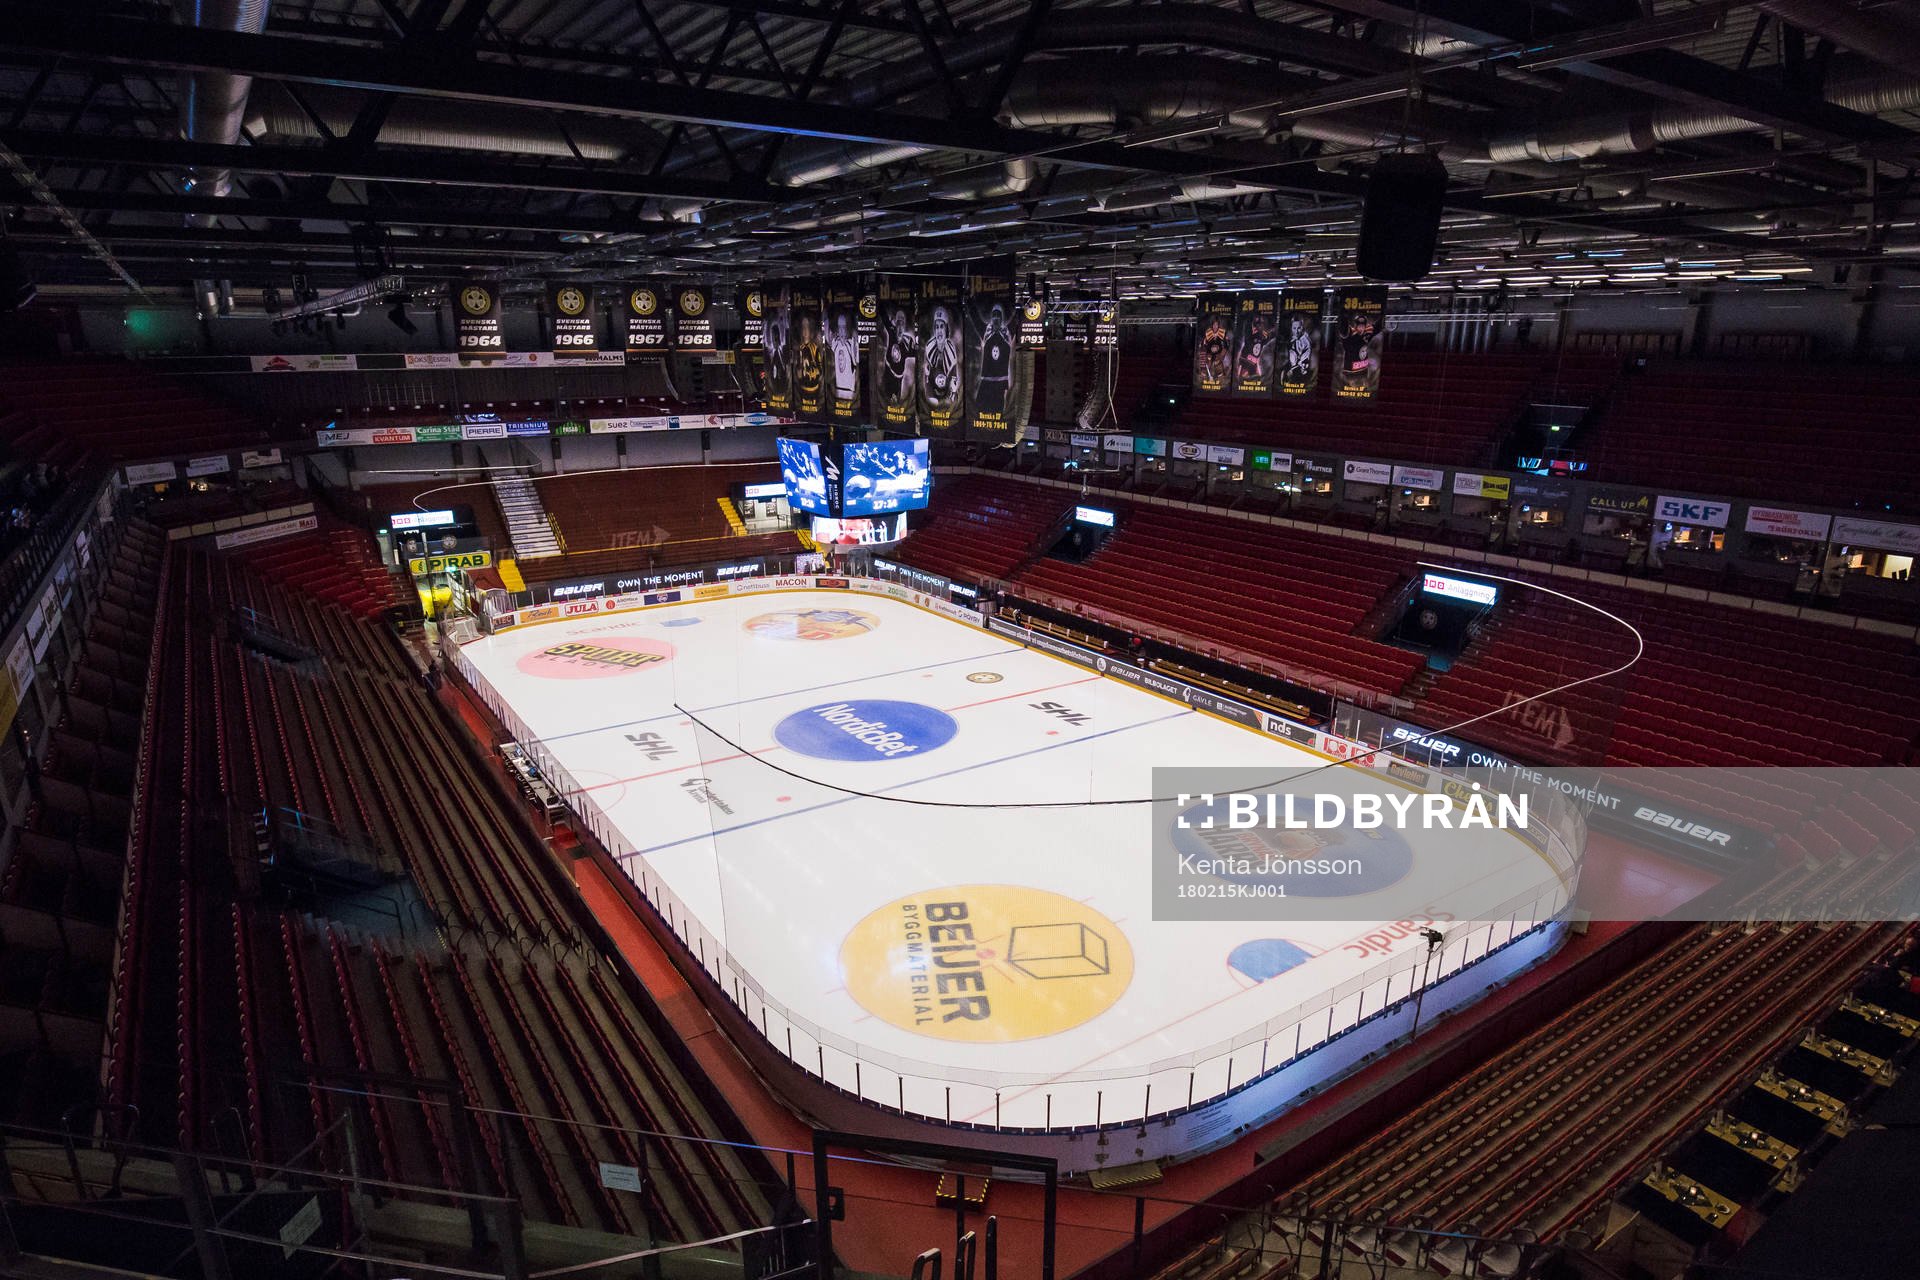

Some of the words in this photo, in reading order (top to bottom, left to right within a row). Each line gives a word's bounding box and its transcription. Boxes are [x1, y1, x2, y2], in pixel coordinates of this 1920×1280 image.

[459, 335, 501, 347] 1964
[555, 334, 594, 346] 1966
[628, 334, 665, 345] 1967
[677, 334, 713, 345] 1968
[468, 428, 501, 436] PIERRE
[507, 422, 548, 430] TRIENNIUM
[374, 434, 412, 443] KVANTUM
[1590, 496, 1616, 507] CALL
[1621, 501, 1636, 510] UP
[1661, 500, 1724, 521] SKF
[430, 554, 484, 571] PIRAB
[553, 582, 605, 597] BAUER
[618, 577, 640, 589] OWN
[643, 575, 662, 585] THE
[664, 571, 704, 583] MOMENT
[717, 563, 759, 576] BAUER
[775, 578, 807, 587] MACON
[566, 602, 598, 615] JULA
[544, 642, 665, 668] SPORT
[1028, 701, 1093, 727] SHL
[812, 703, 920, 758] NordicBet
[1270, 720, 1292, 736] nds
[624, 732, 678, 761] SHL
[1392, 727, 1460, 758] BAUER
[1471, 752, 1508, 773] OWN
[1512, 765, 1542, 785] THE
[1547, 776, 1621, 810] MOMENT
[1633, 805, 1732, 847] BAUER
[1342, 906, 1456, 959] Scandic
[902, 904, 934, 1026] BYGGMATERIAL
[924, 901, 991, 1024] BEIJER
